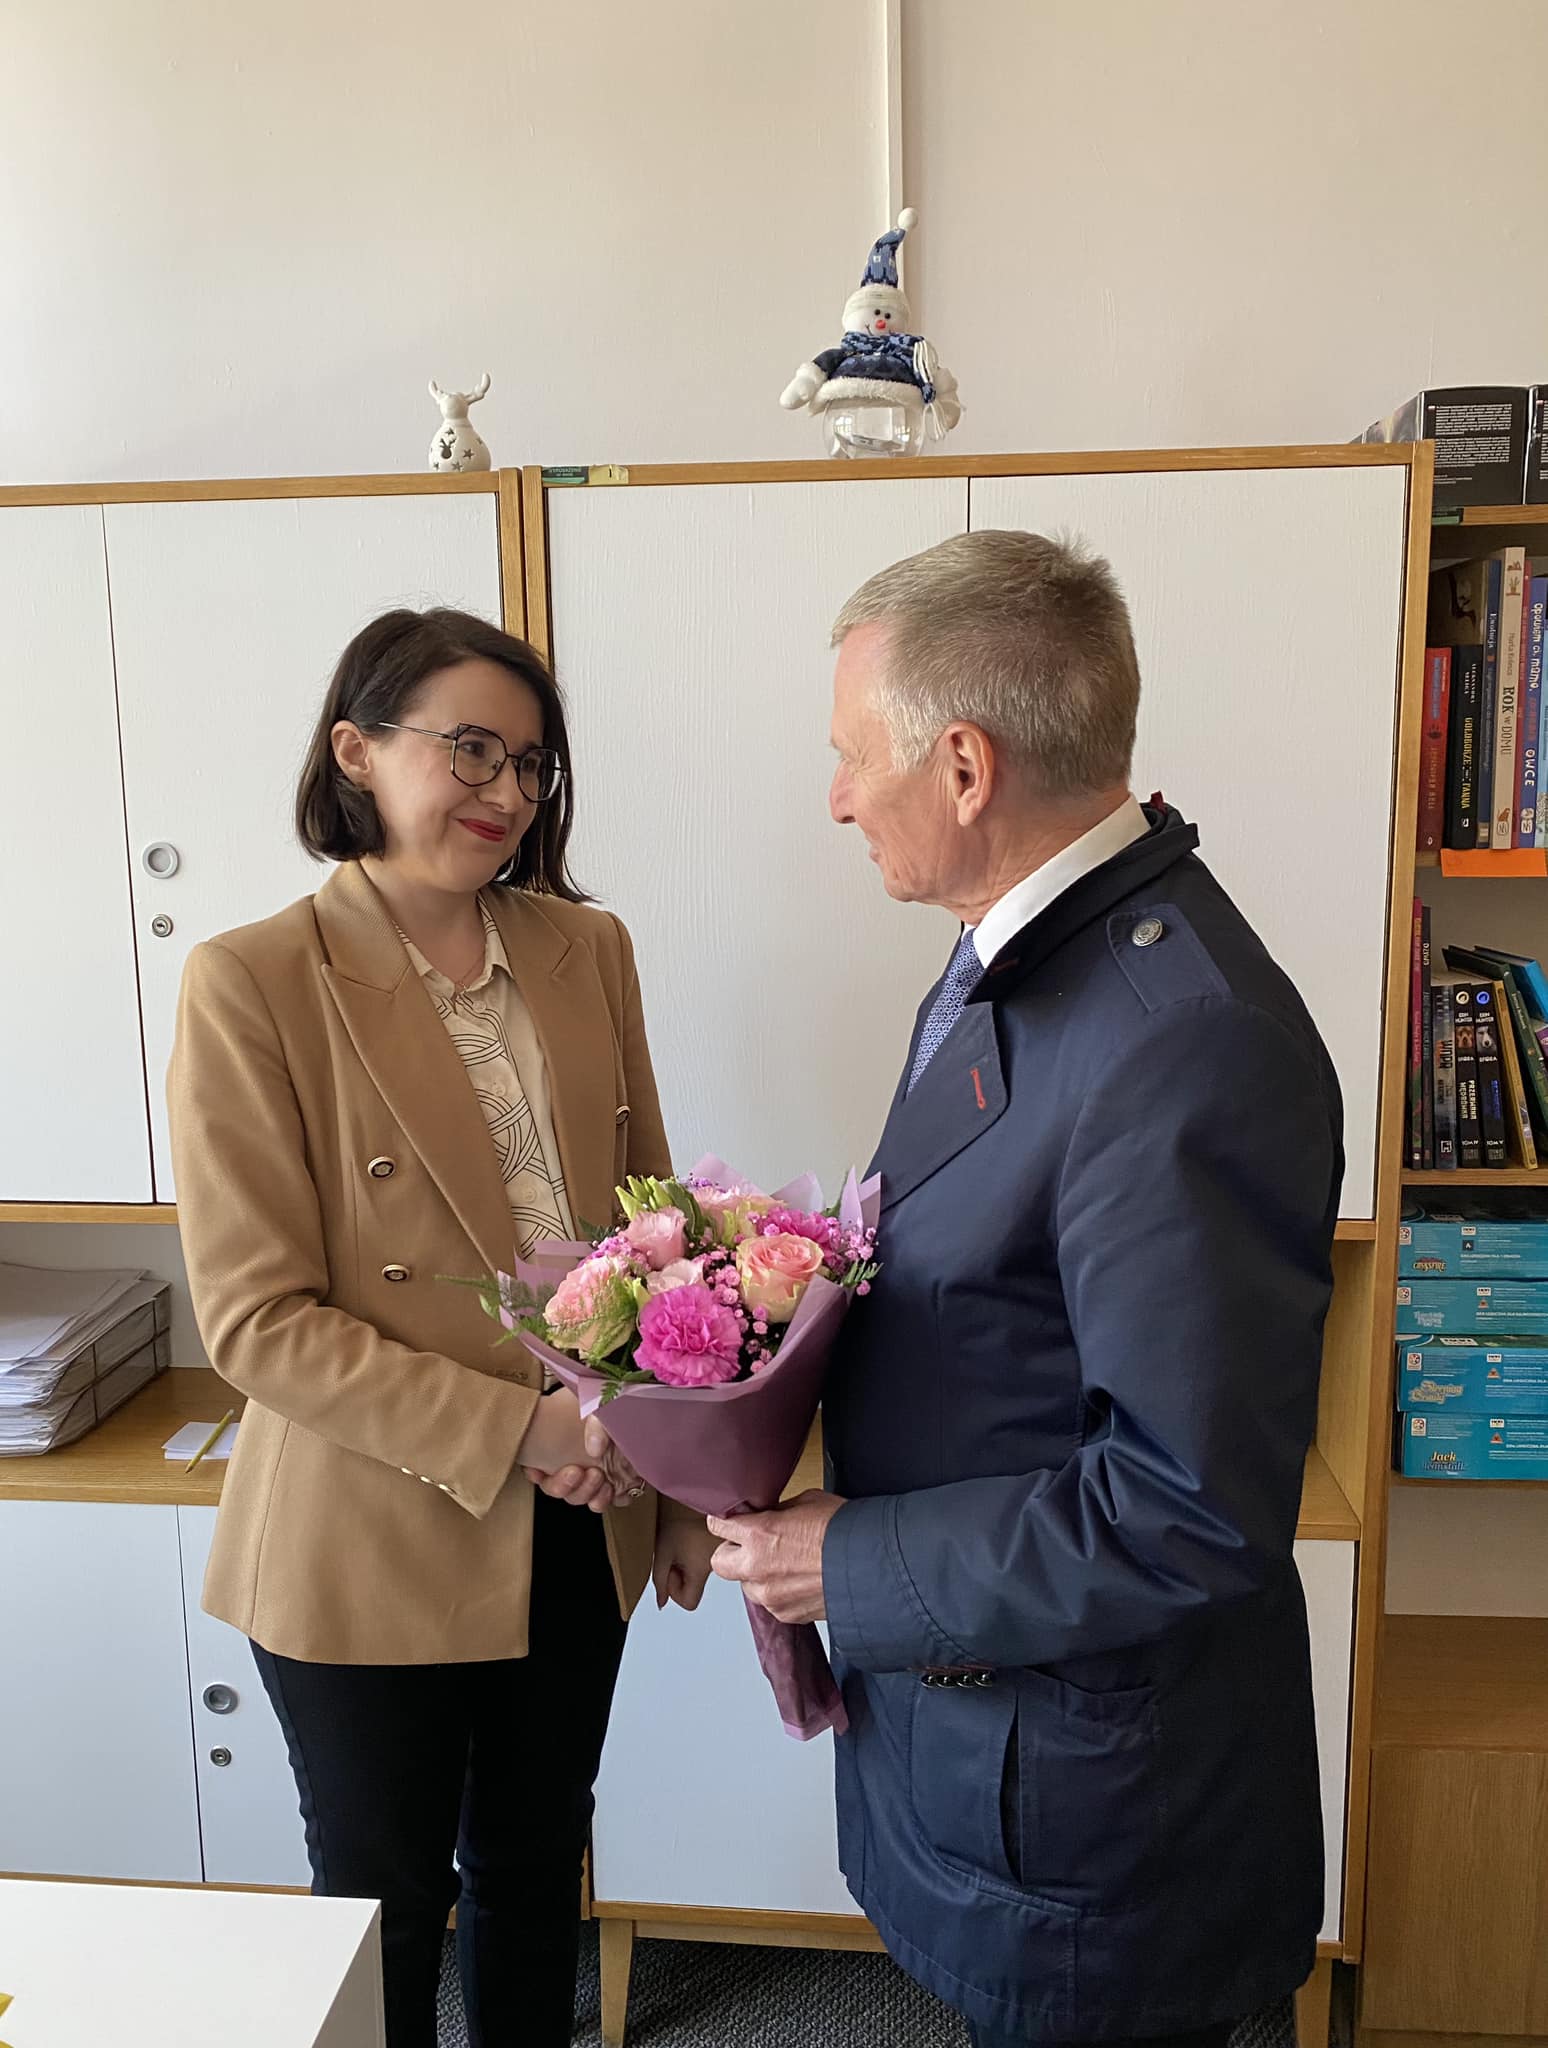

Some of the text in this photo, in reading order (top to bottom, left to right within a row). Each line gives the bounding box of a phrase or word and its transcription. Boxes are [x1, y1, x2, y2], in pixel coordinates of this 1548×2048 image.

[1487, 613, 1497, 649] Ewolucja
[1502, 686, 1515, 713] ROK
[1501, 725, 1513, 756] DOMU
[1524, 749, 1536, 787] OWCE
[1439, 1039, 1453, 1069] WOPR
[1430, 1451, 1456, 1462] Jack
